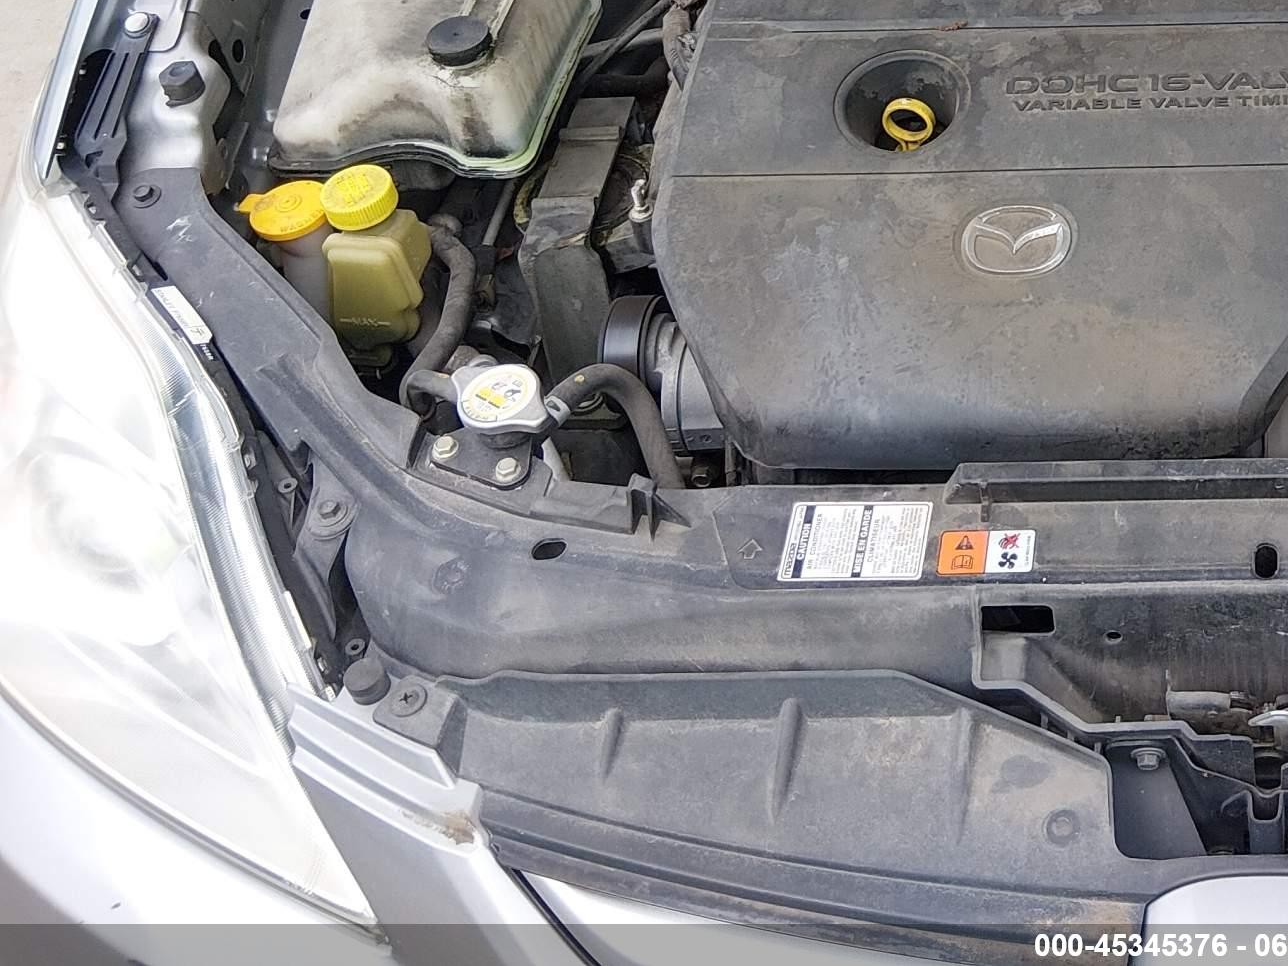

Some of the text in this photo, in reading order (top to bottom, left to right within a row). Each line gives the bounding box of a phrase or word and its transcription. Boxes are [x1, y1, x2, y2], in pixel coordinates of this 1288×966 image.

[1006, 73, 1140, 95] DOHC
[1012, 95, 1142, 111] VARIABLE
[1148, 95, 1230, 109] VALVE
[796, 523, 812, 560] CAUTION
[809, 513, 823, 555] CONDITIONER
[852, 509, 872, 573] MISE EN GARDE
